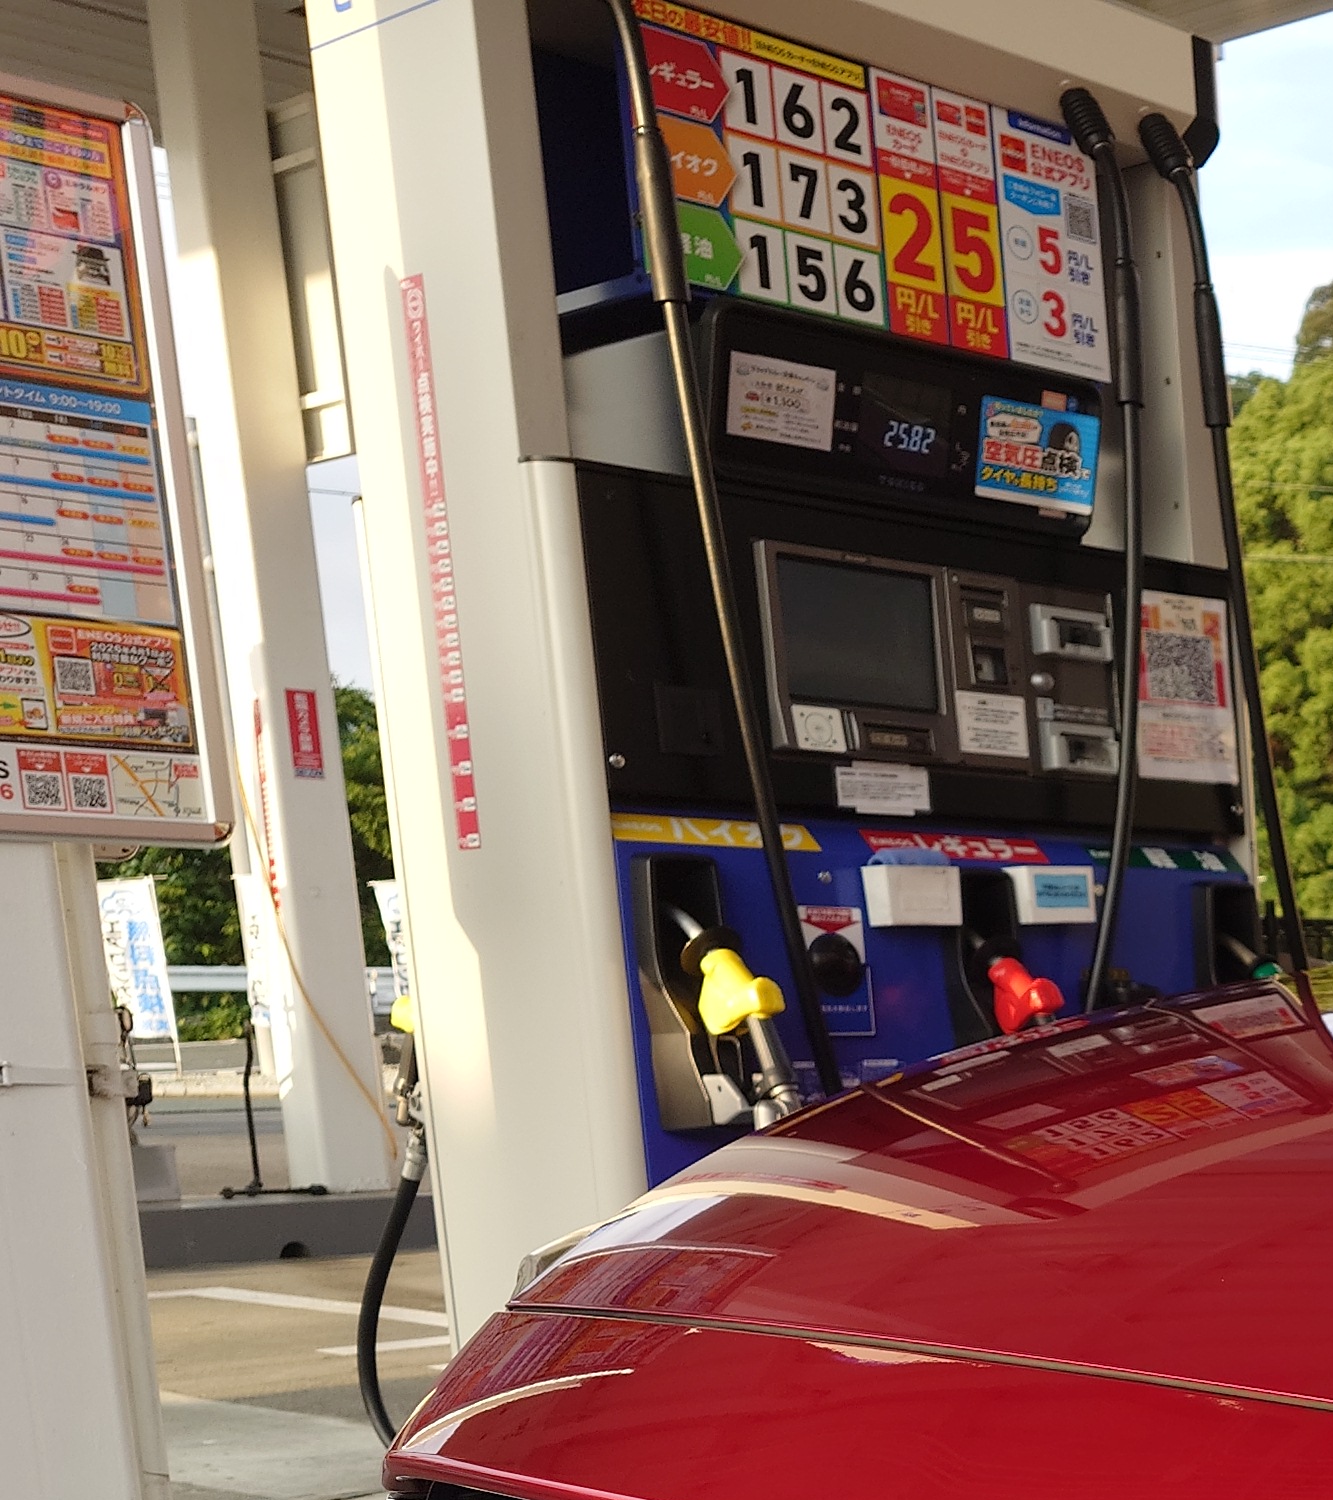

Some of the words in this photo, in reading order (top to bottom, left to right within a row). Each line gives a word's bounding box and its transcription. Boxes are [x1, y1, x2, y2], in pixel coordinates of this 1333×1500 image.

[736, 67, 862, 156] 162
[672, 150, 718, 178] イオク
[1031, 143, 1085, 174] ENEOS
[1031, 161, 1090, 191] 公式アプリ
[742, 151, 868, 234] 173
[889, 192, 935, 282] 2
[951, 206, 996, 294] 5
[1037, 225, 1062, 276] 5
[750, 234, 875, 313] 156
[895, 286, 940, 320] 円/L
[956, 301, 1000, 335] 円/L
[1041, 289, 1067, 339] 3
